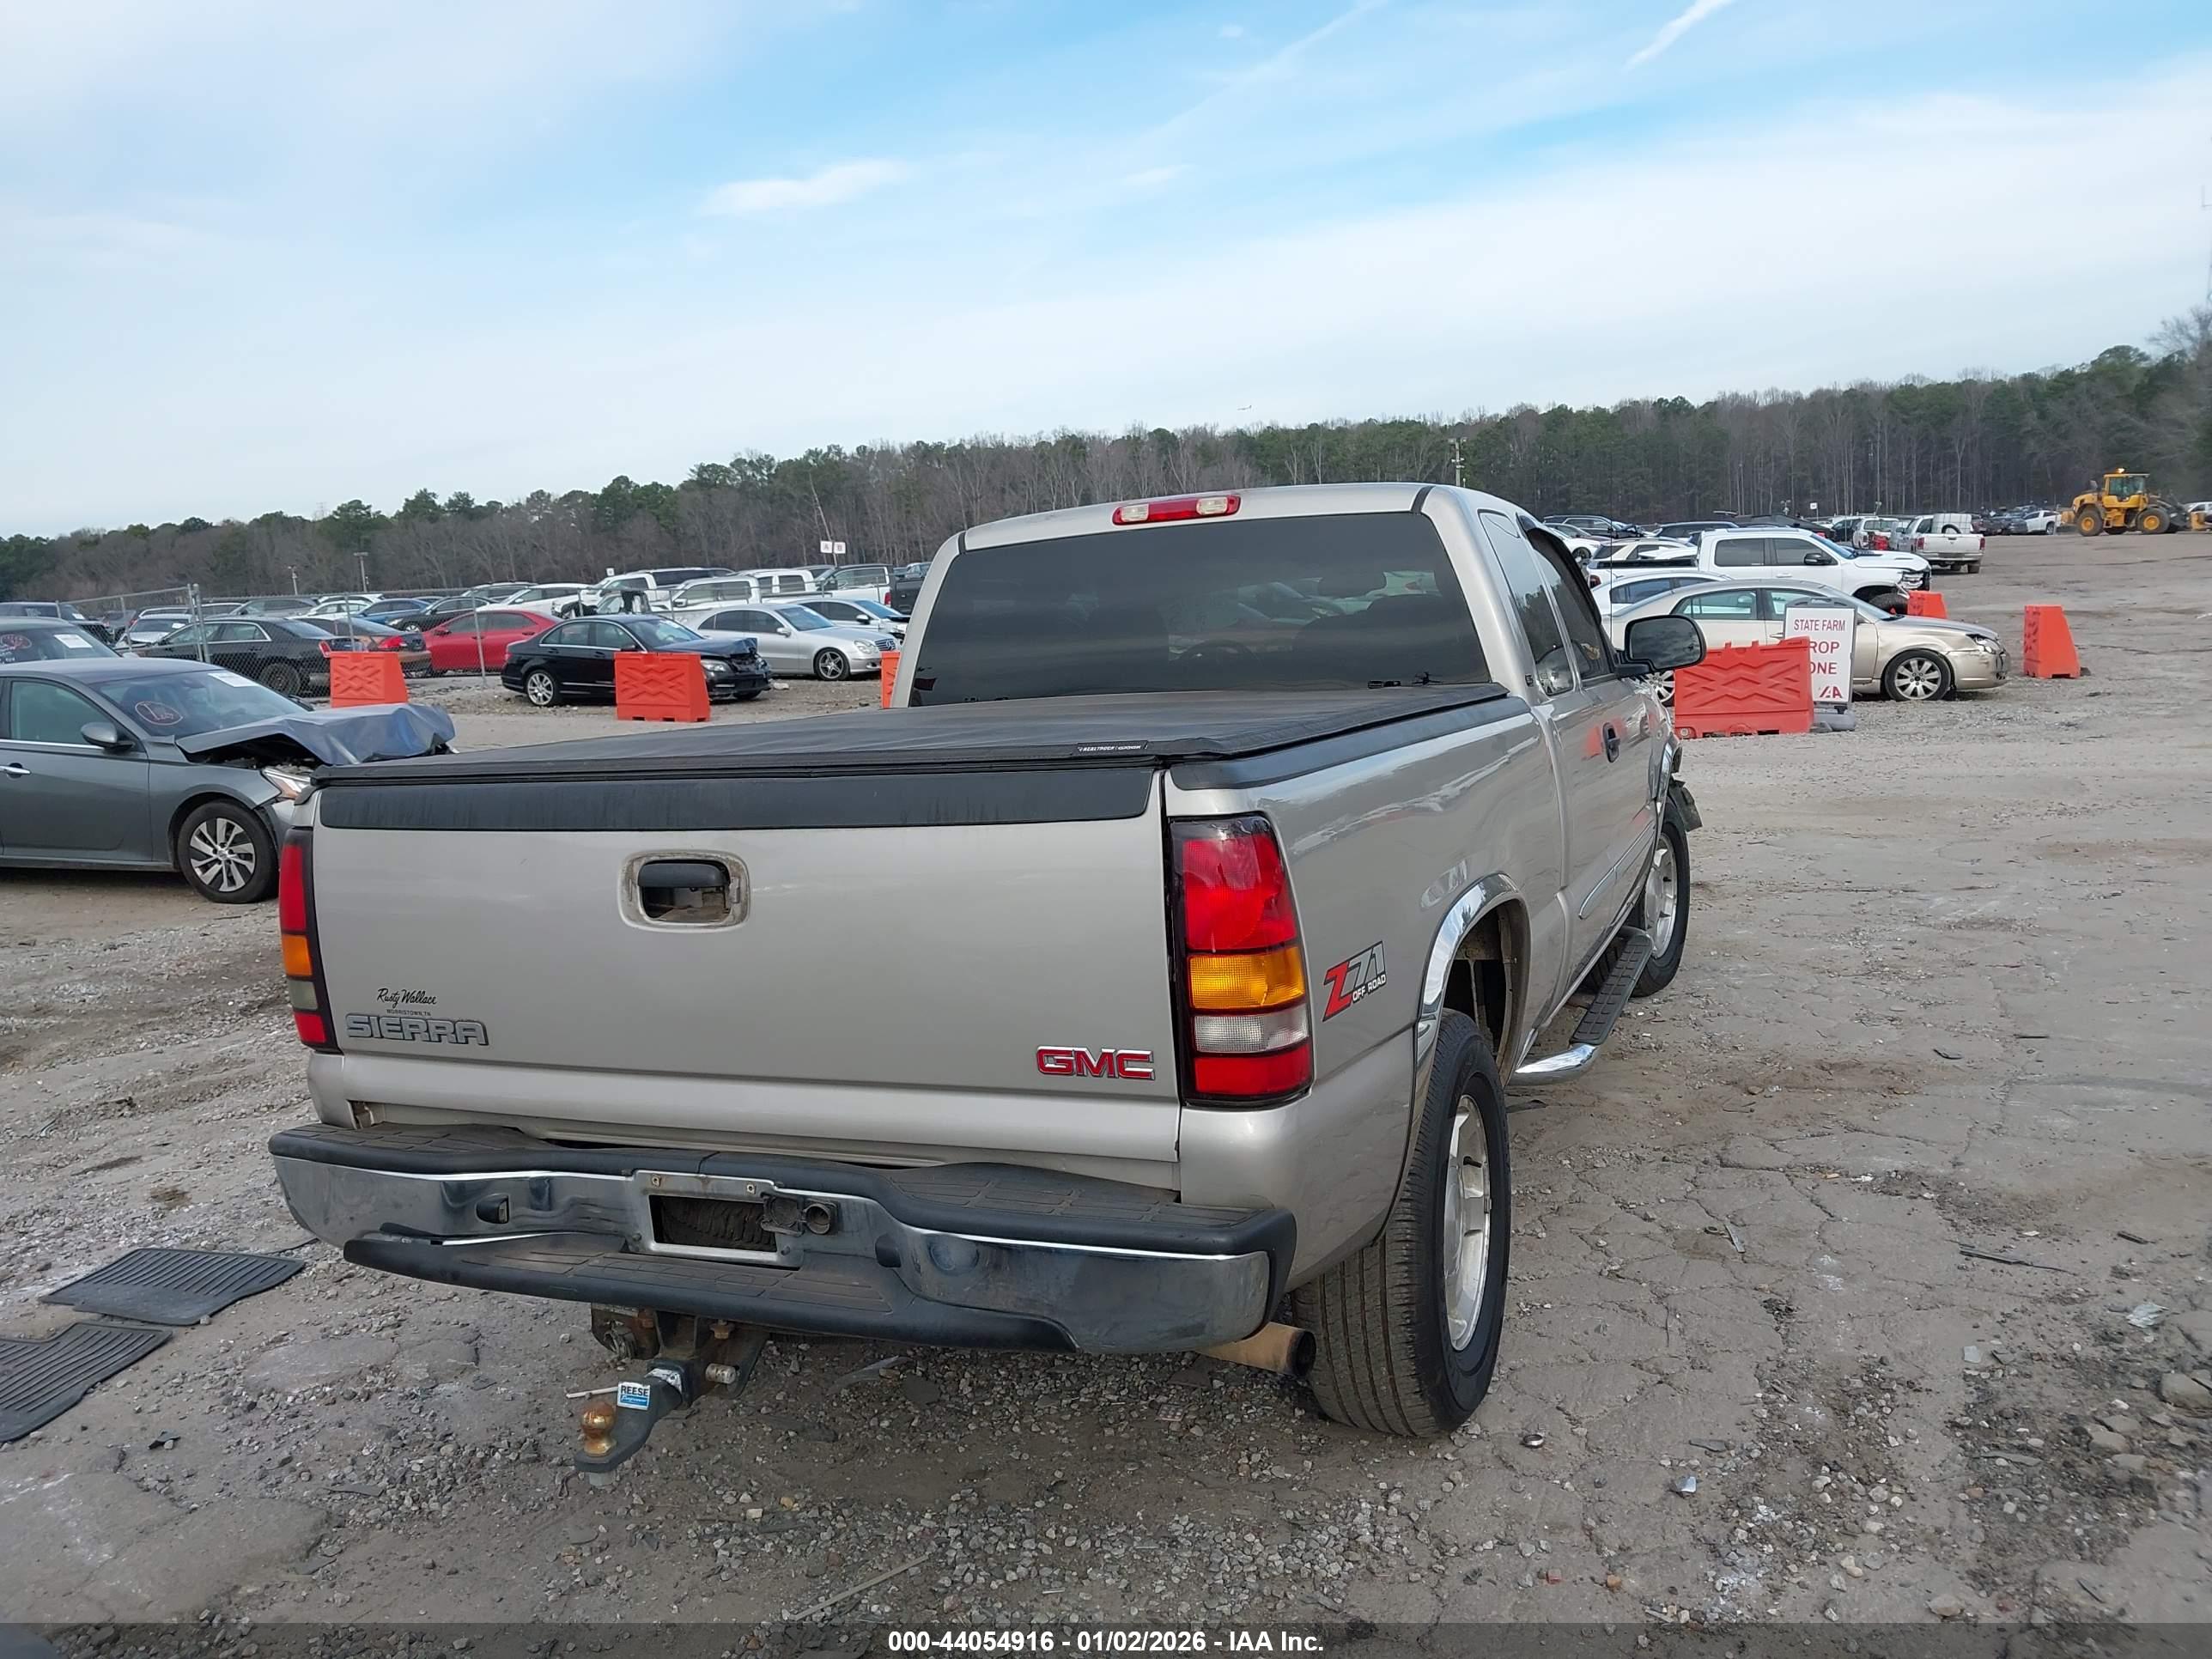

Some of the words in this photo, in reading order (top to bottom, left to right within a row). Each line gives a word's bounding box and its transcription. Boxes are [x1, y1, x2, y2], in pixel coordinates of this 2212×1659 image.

[1794, 619, 1820, 631] STATE
[1821, 619, 1845, 632] FARM
[1809, 641, 1839, 653] ROP
[1810, 661, 1837, 675] ONE
[1322, 940, 1386, 1022] Z71
[1352, 986, 1366, 1002] OFF
[1367, 974, 1387, 994] ROAD
[376, 988, 400, 1008] Rusty
[401, 988, 437, 1005] Wallace
[345, 1013, 489, 1045] SIERRA
[1036, 1045, 1155, 1080] GMC
[621, 1384, 649, 1397] REESE
